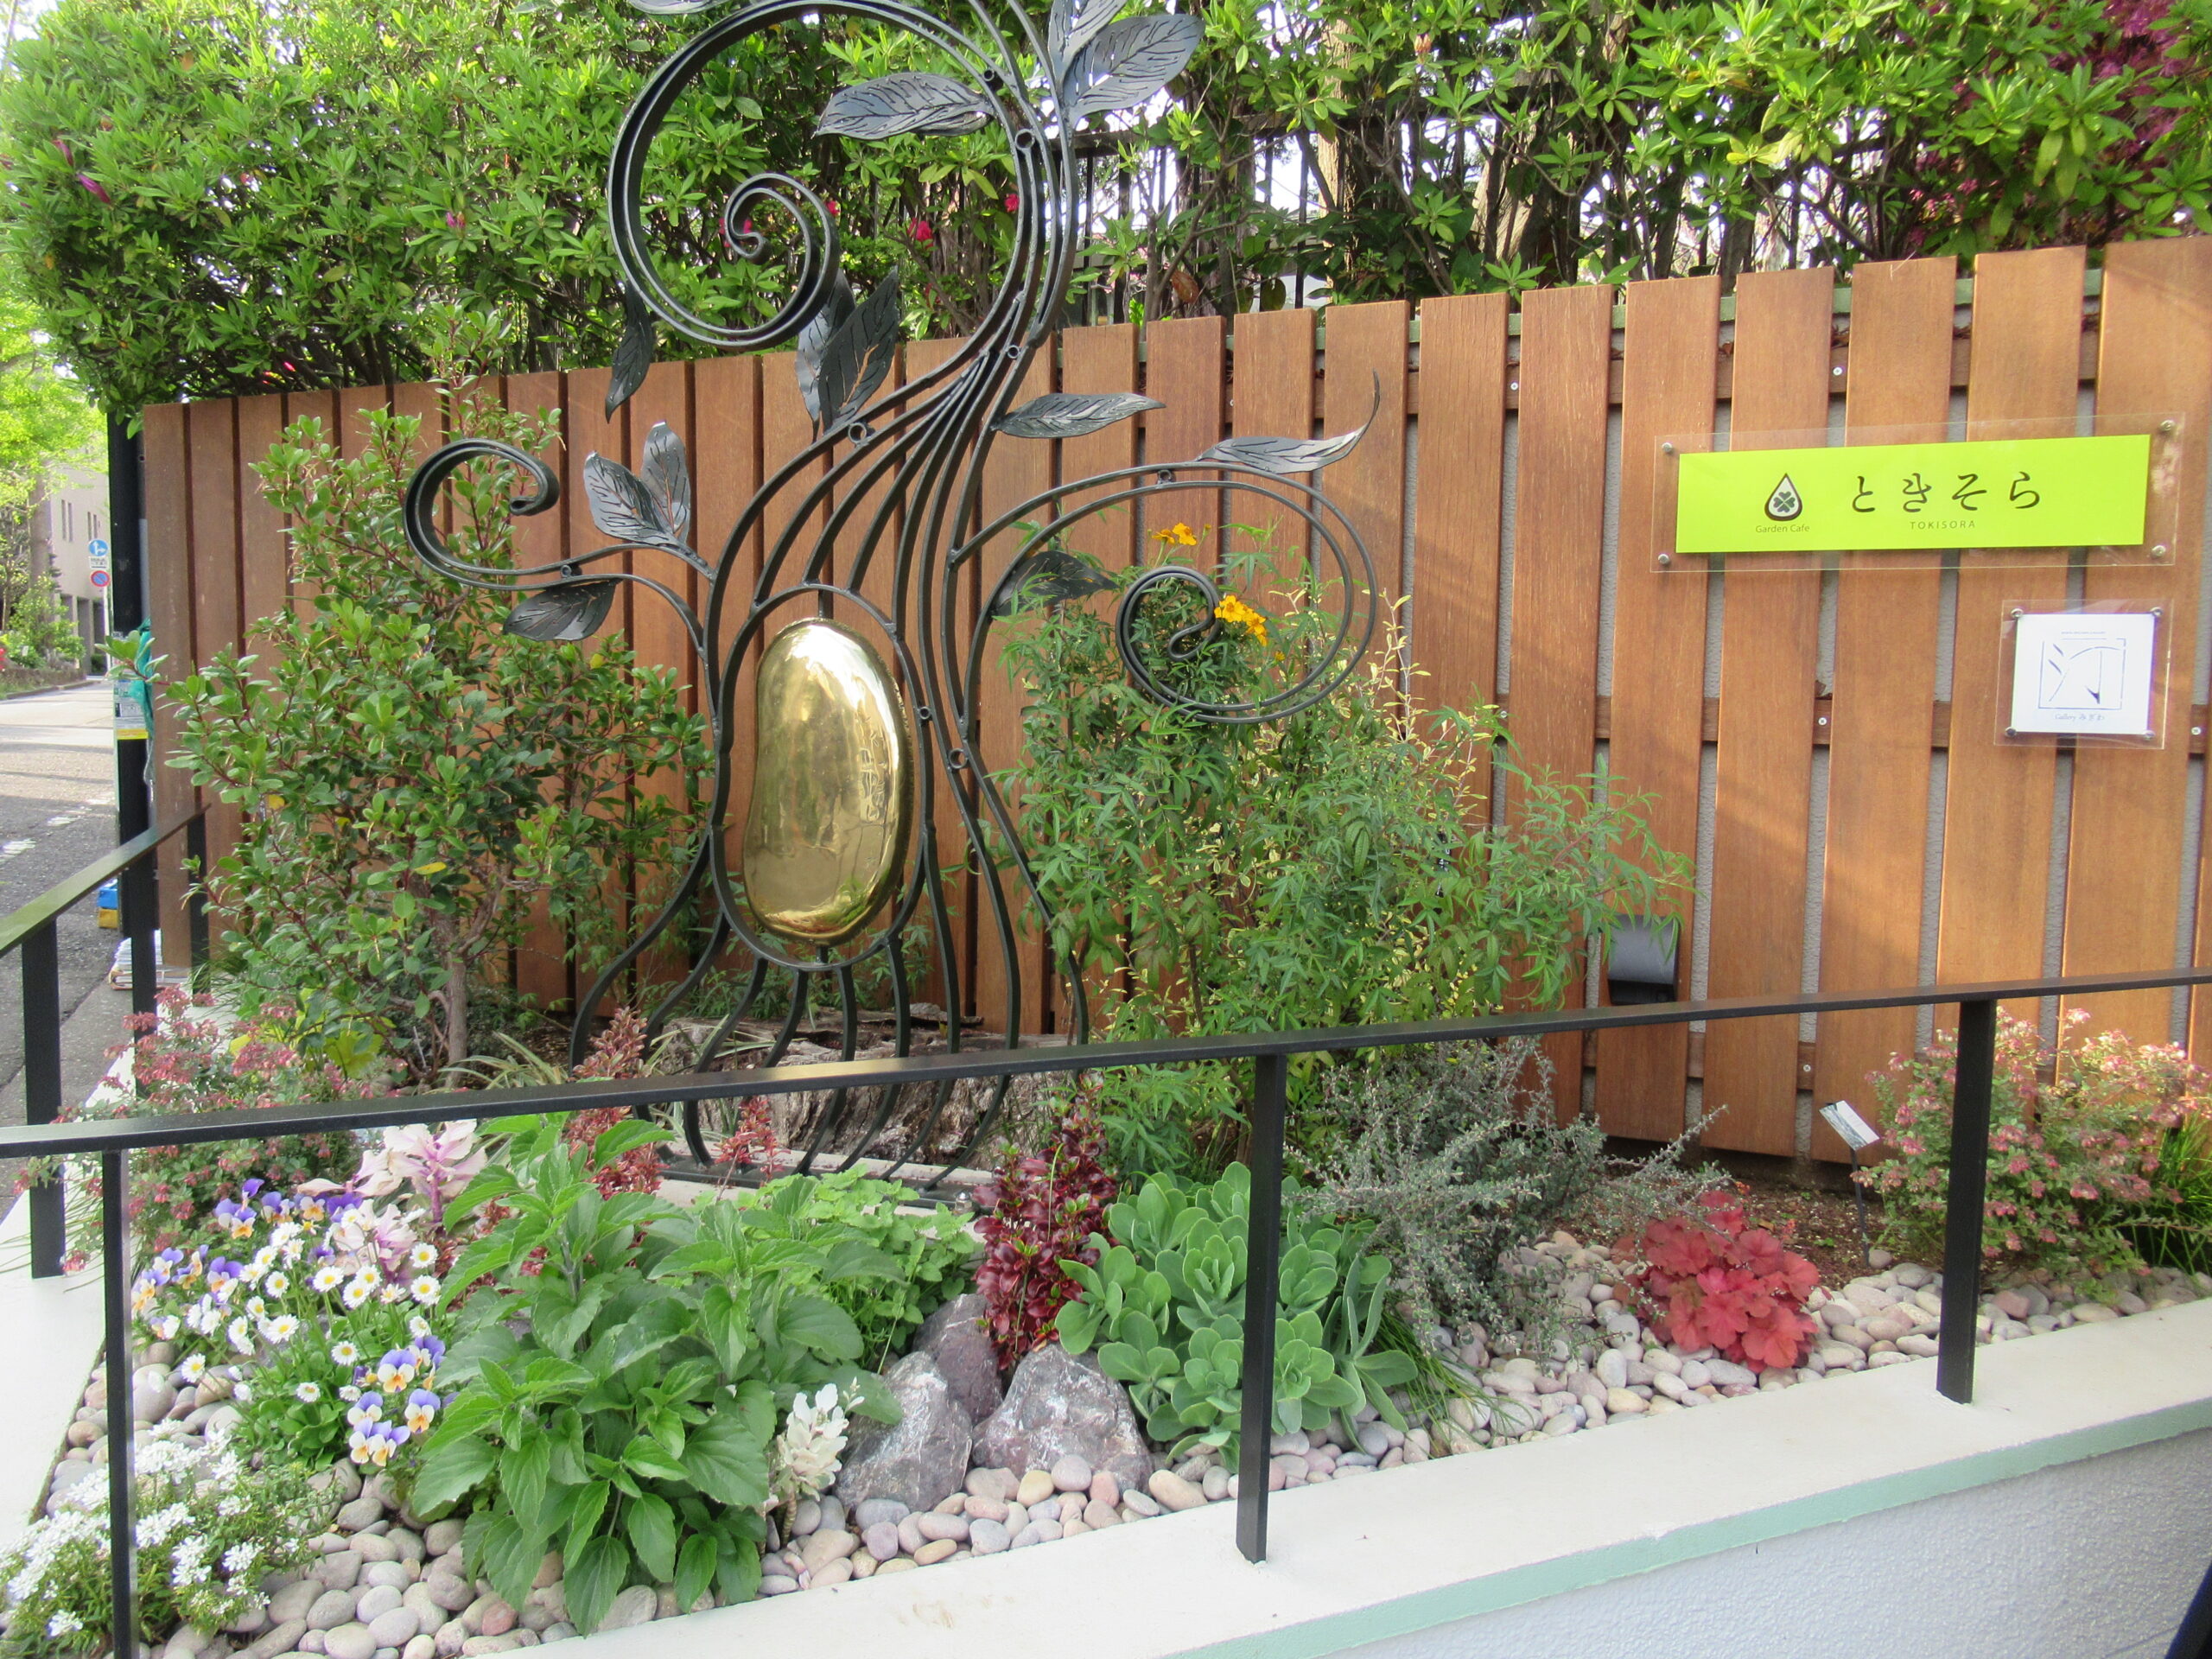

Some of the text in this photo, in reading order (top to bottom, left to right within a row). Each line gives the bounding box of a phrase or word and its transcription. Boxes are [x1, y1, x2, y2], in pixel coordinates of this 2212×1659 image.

[1852, 472, 2041, 513] ときそら
[1755, 524, 1810, 533] Garden Cafe
[1910, 520, 1976, 530] TOKISORA
